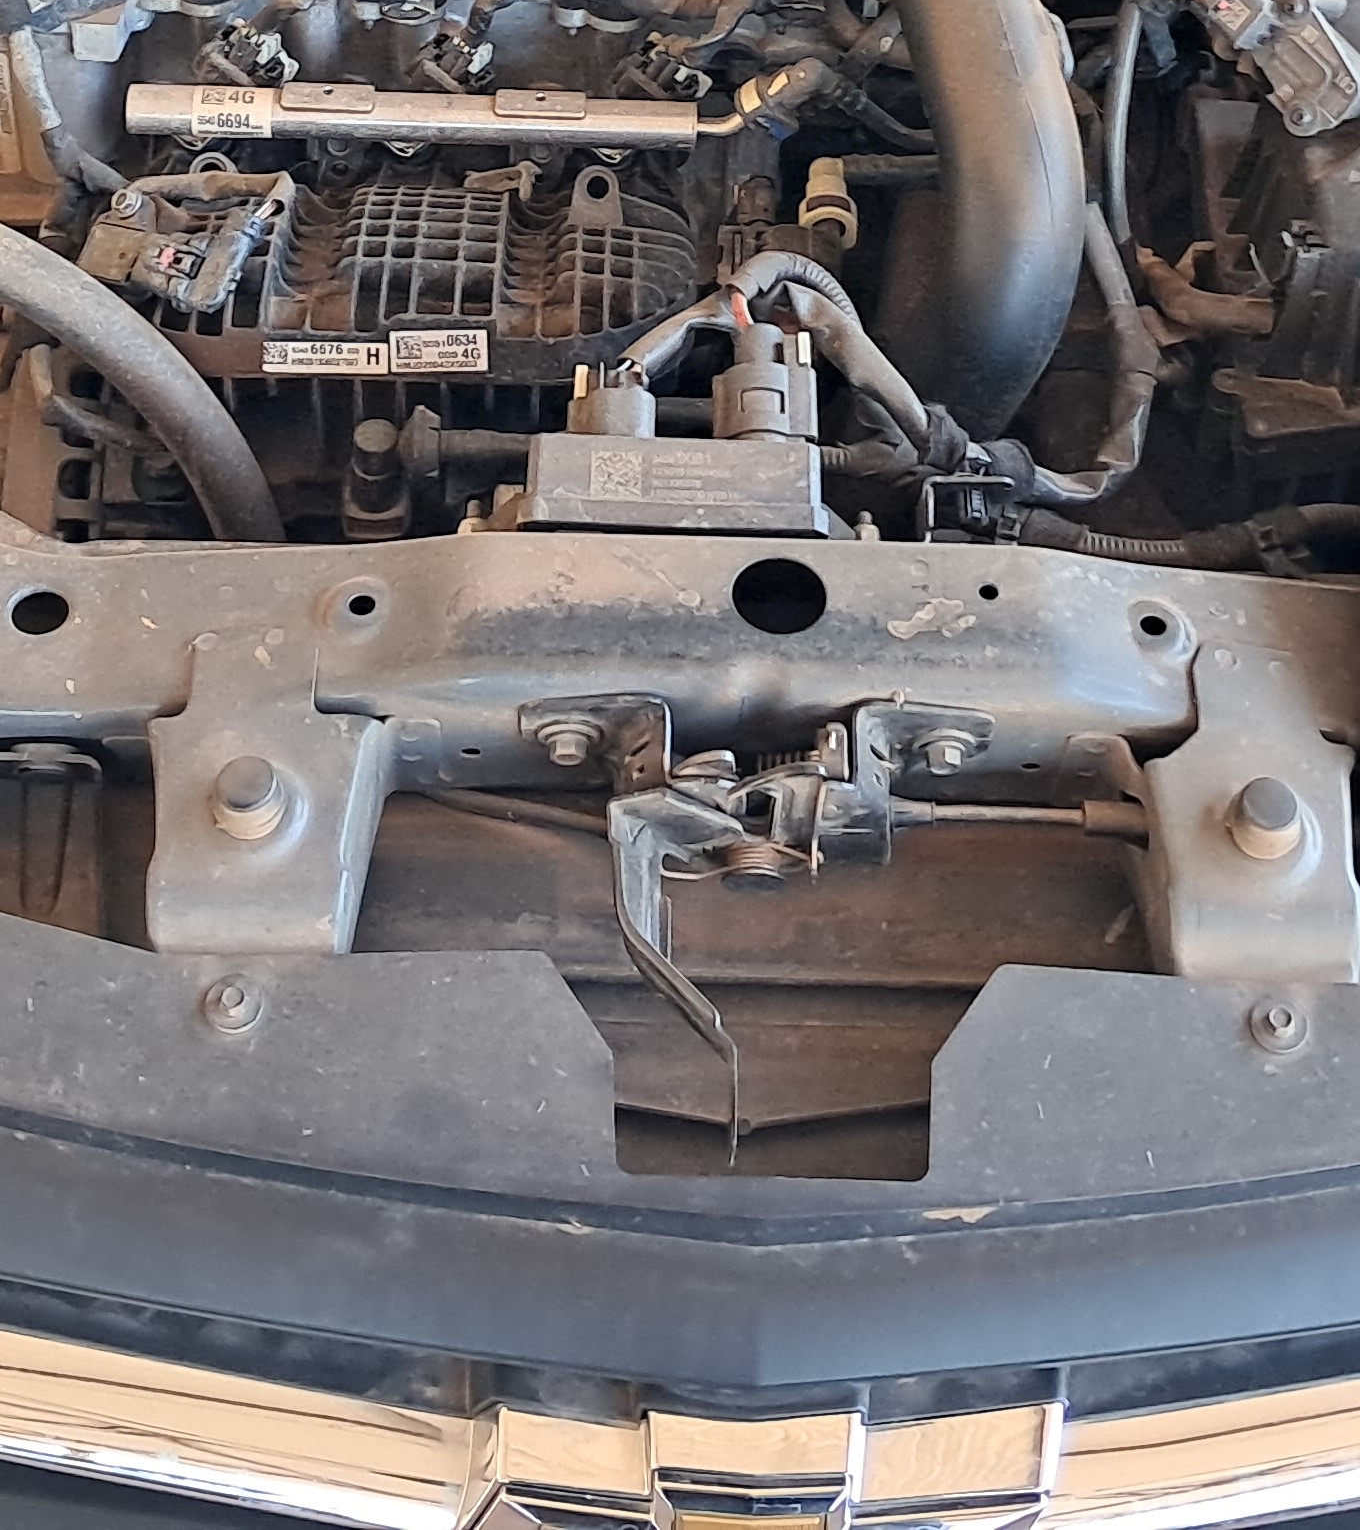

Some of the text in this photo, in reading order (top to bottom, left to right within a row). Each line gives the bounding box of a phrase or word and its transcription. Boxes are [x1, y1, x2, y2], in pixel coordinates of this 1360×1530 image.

[227, 89, 256, 105] 4G
[366, 346, 381, 366] H
[460, 347, 482, 360] 4G
